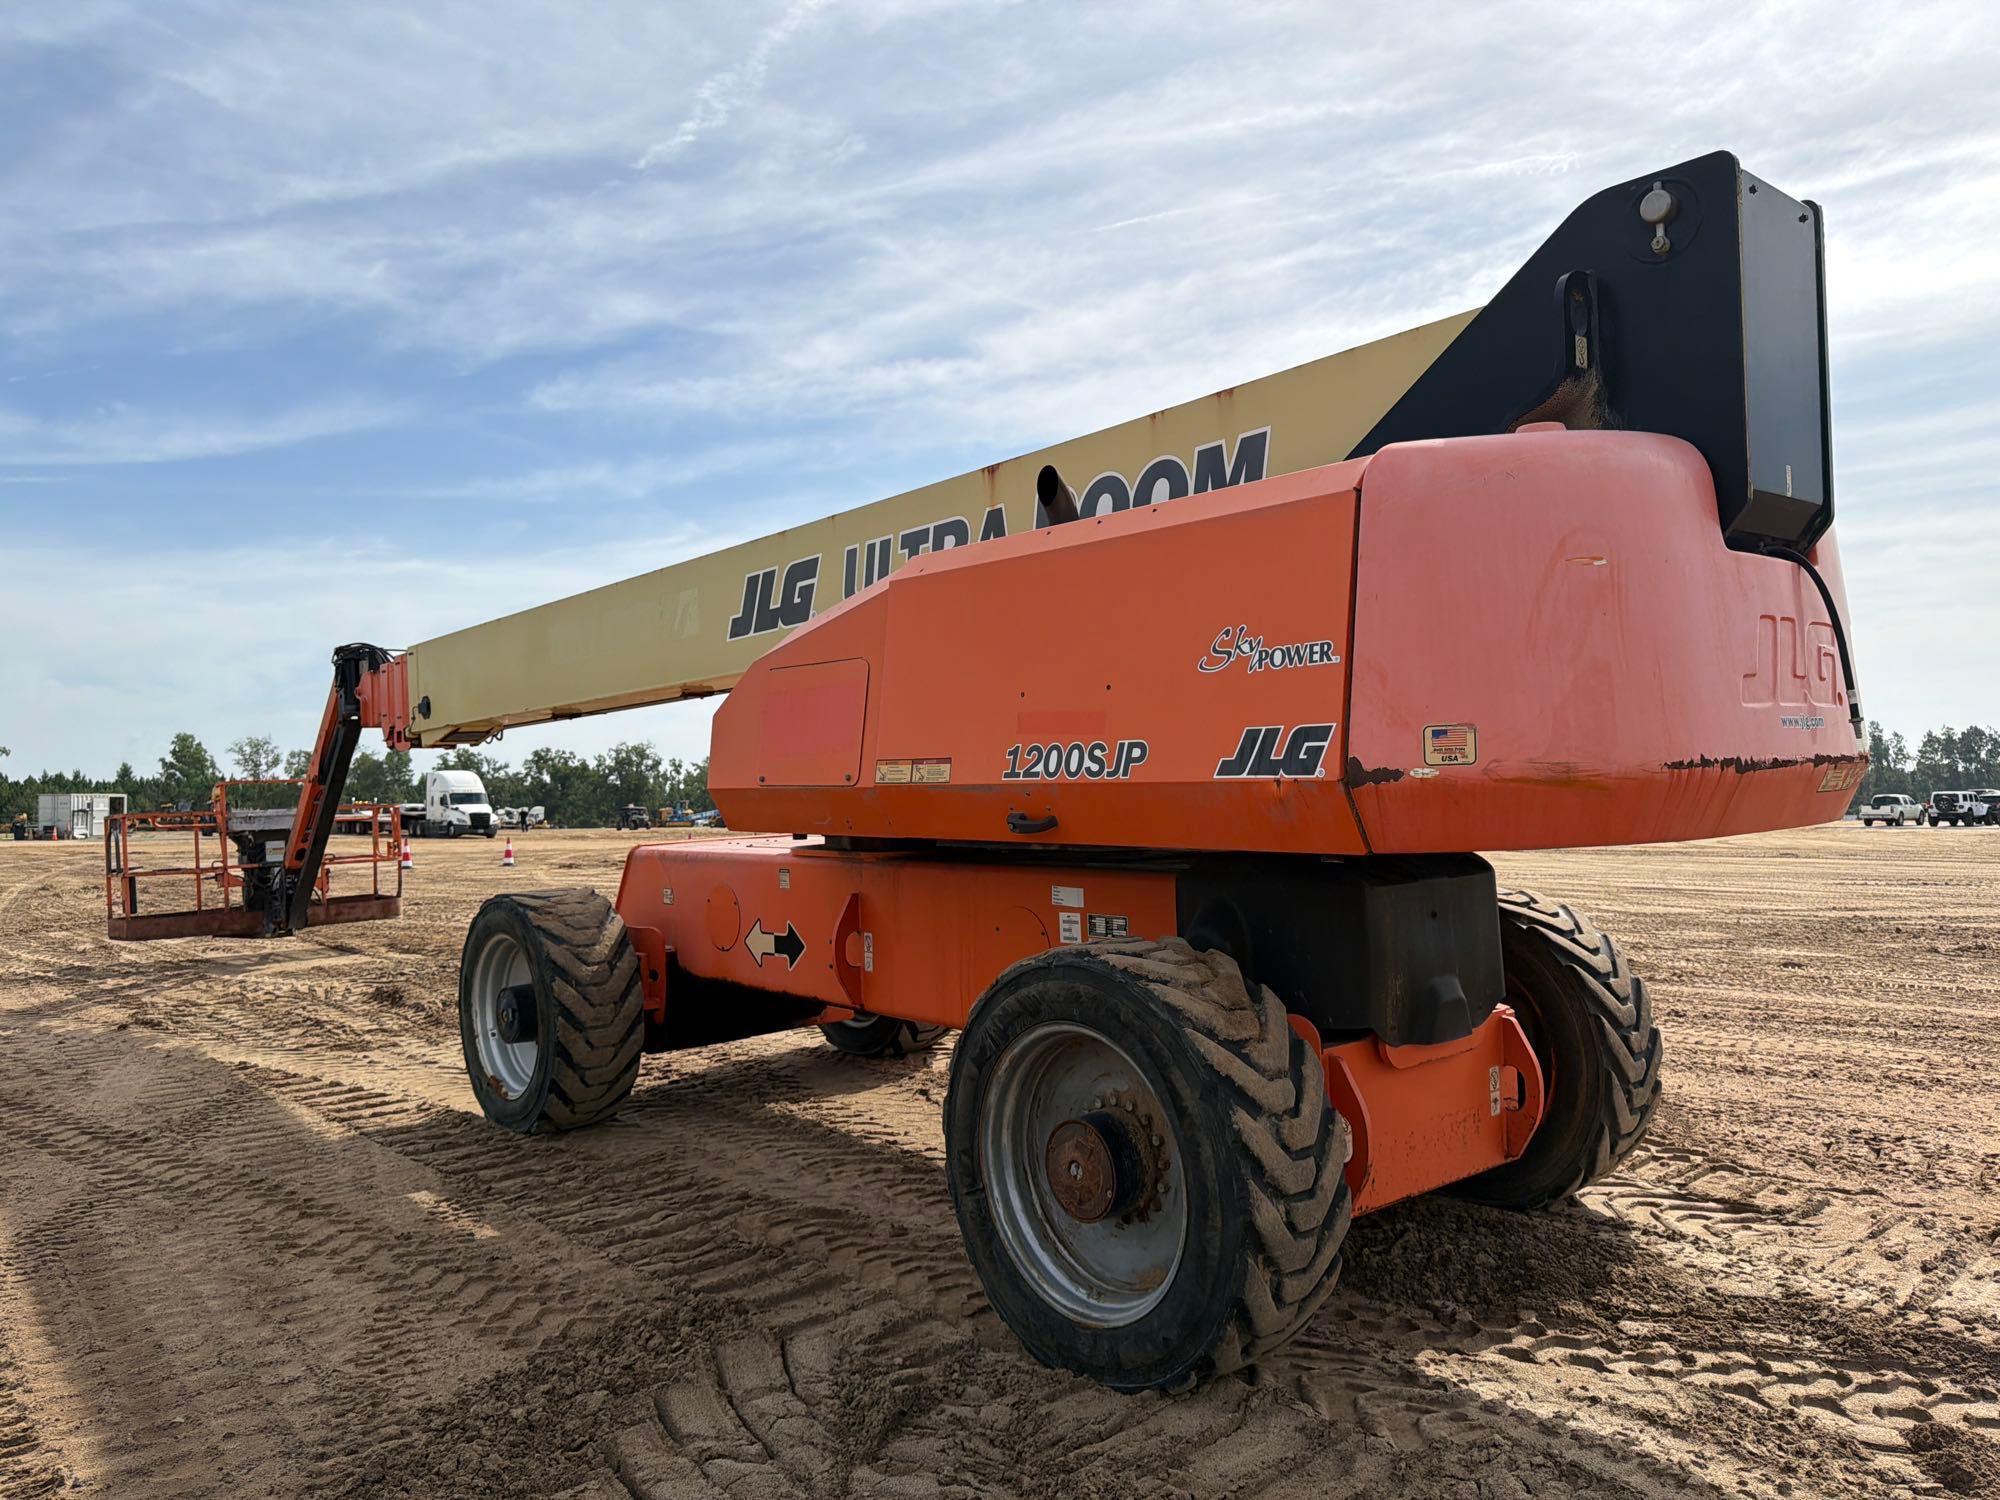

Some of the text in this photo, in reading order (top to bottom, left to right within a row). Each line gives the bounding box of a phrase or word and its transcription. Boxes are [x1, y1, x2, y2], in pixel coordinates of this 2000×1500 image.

[727, 553, 822, 641] JLG
[1033, 425, 1271, 531] OOM
[1780, 715, 1825, 730] www.jlg.com
[1002, 740, 1149, 780] 1200SJP
[1214, 723, 1337, 778] JLG
